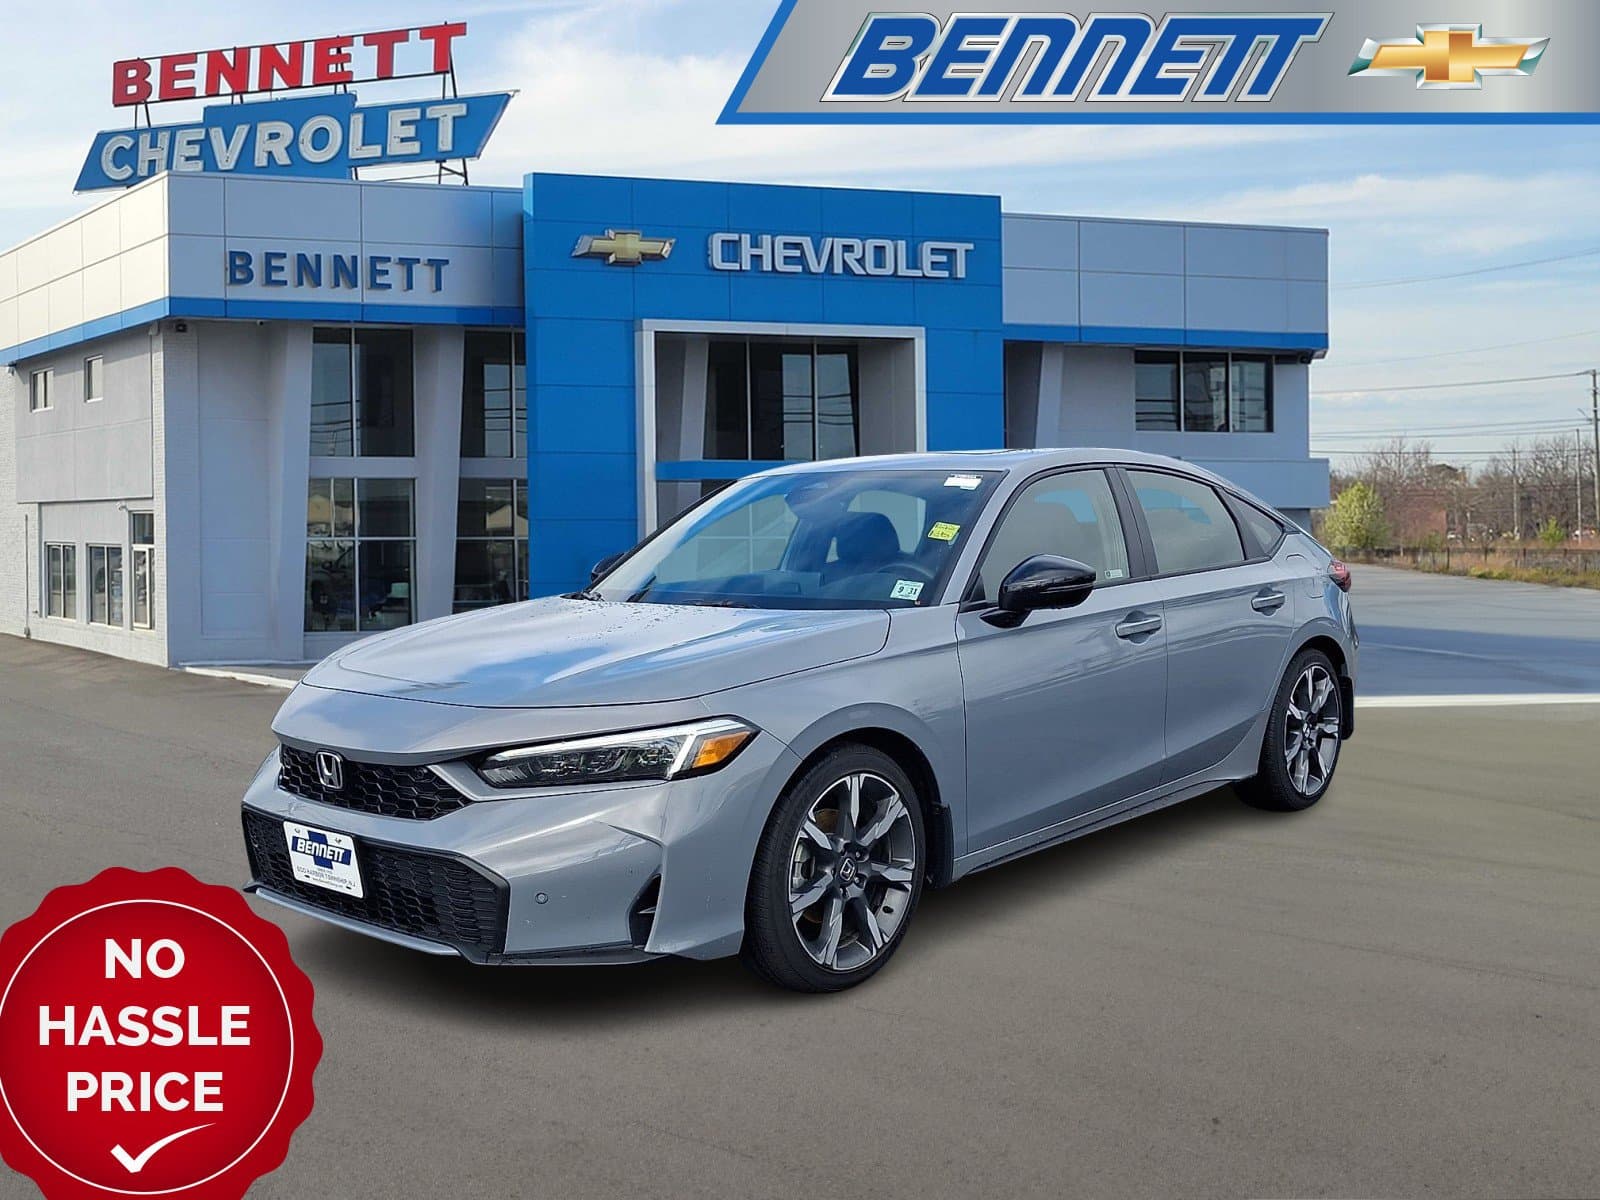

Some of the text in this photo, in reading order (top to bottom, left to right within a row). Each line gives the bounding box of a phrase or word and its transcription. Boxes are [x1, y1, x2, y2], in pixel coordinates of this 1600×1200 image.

[112, 22, 467, 107] BENNETT
[100, 103, 468, 182] CHEVROLET
[225, 250, 450, 293] BENNETT
[708, 232, 975, 279] CHEVROLET
[296, 838, 345, 863] BENNETT
